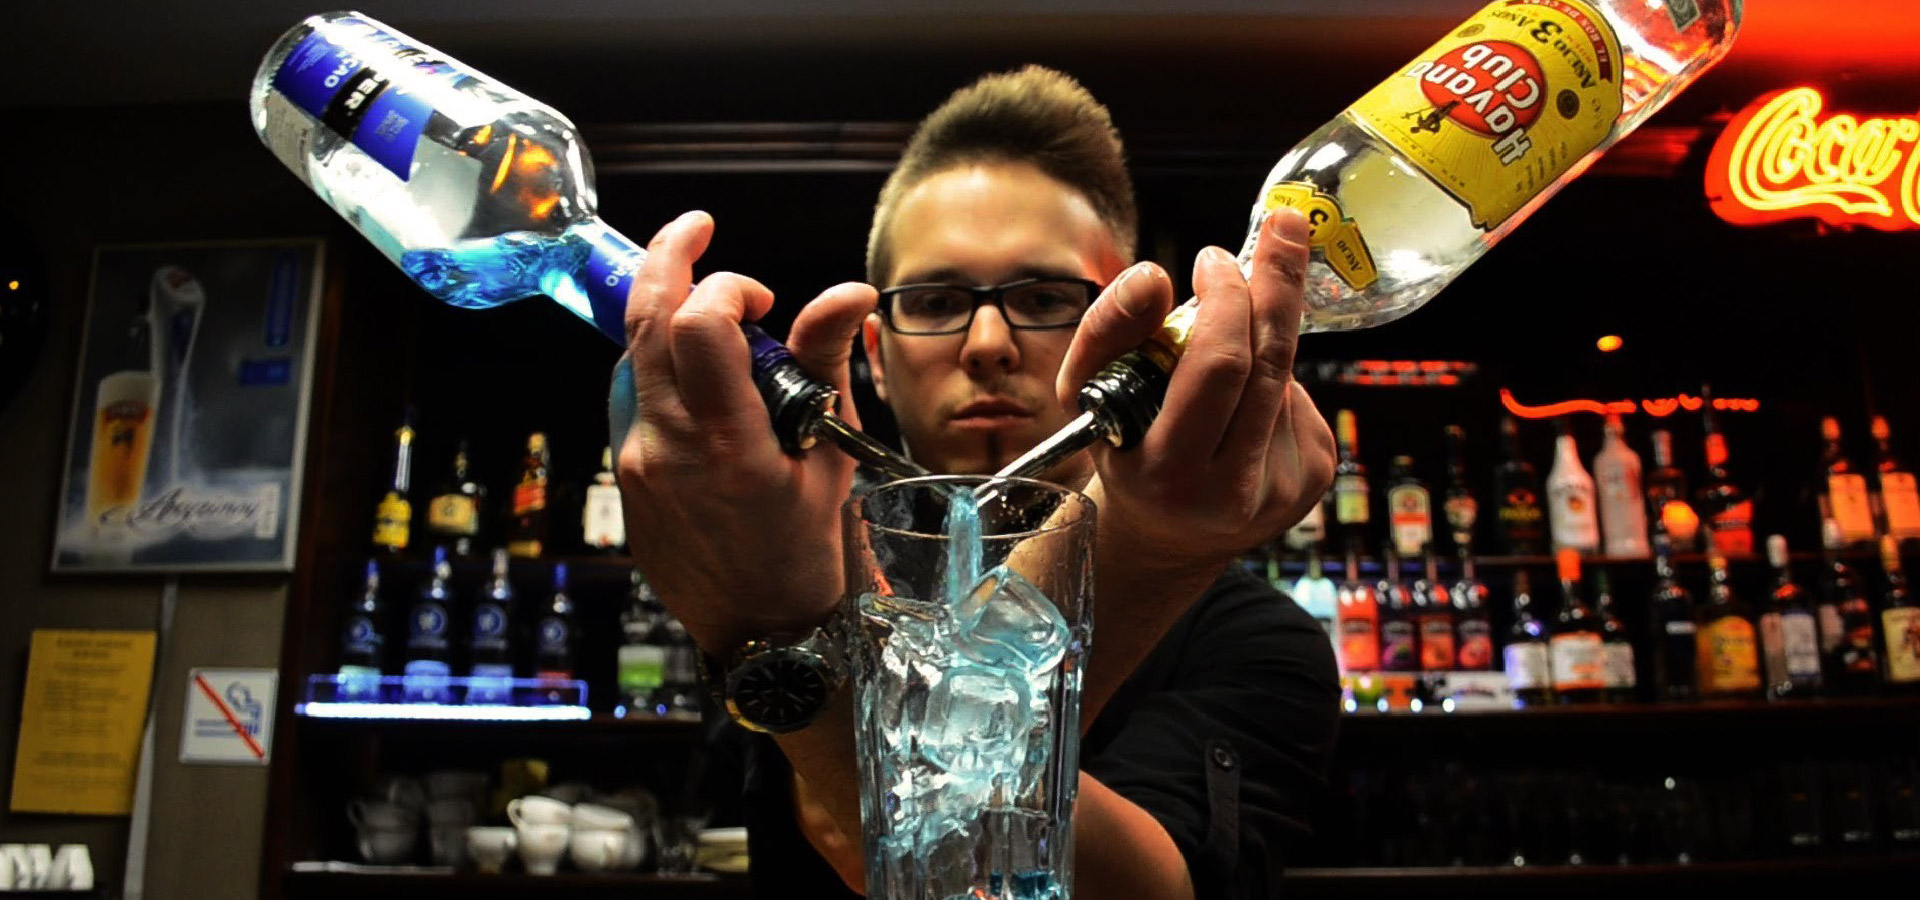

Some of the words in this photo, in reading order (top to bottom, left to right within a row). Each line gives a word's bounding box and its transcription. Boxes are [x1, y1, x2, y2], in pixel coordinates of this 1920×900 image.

[1530, 20, 1563, 43] 3
[1461, 43, 1540, 109] Club
[1403, 60, 1532, 167] Havana
